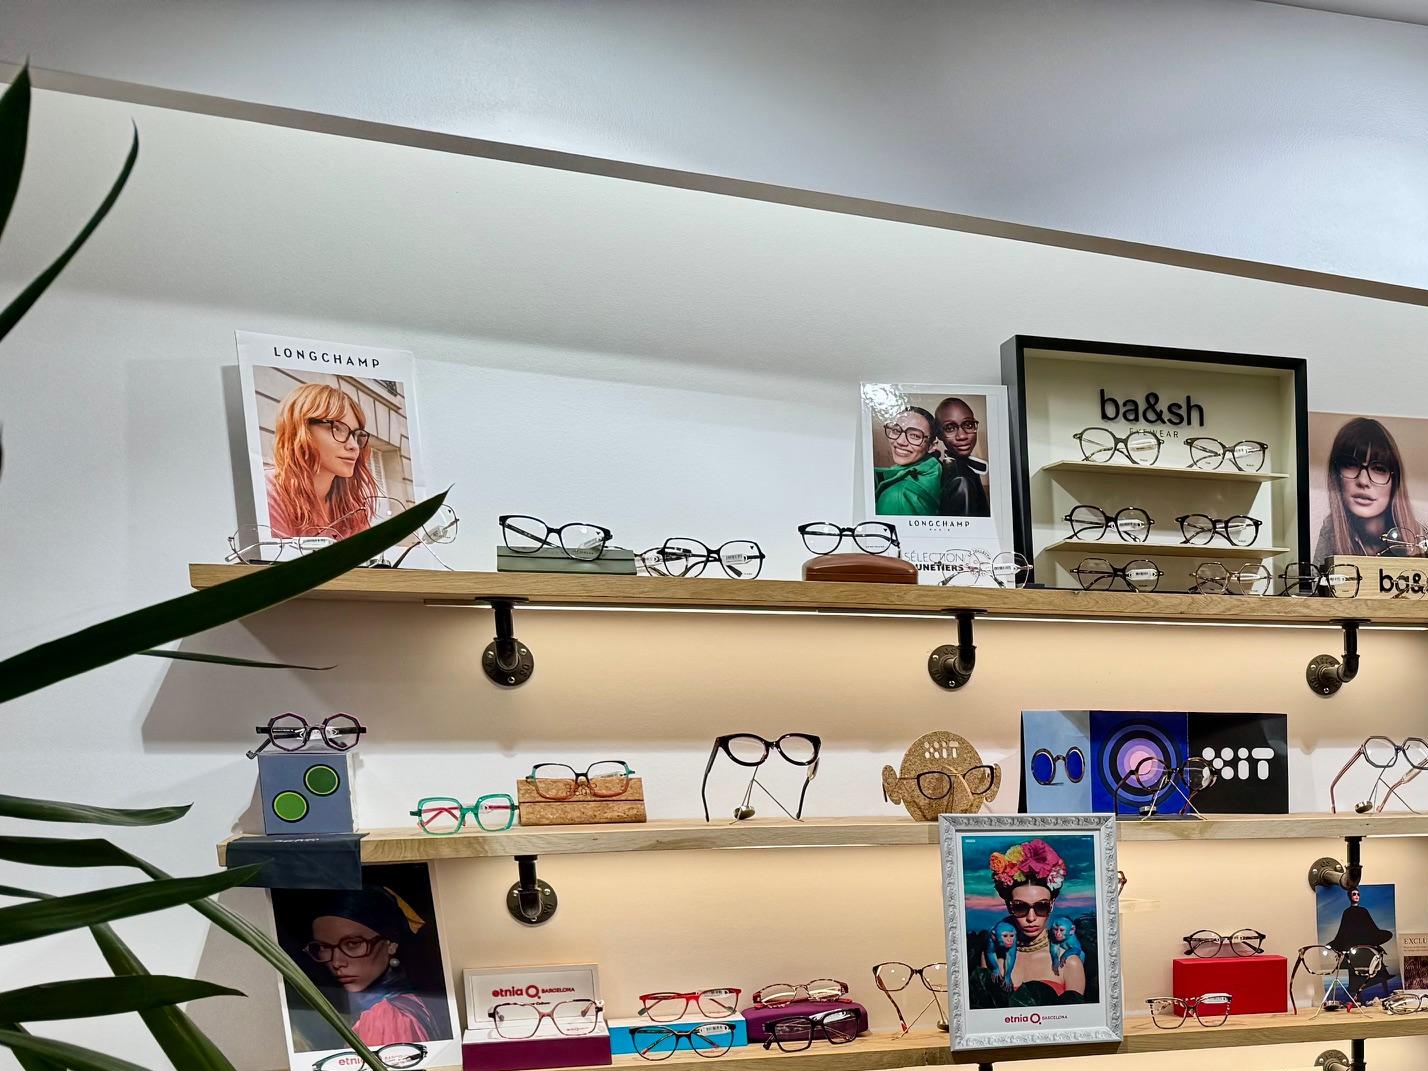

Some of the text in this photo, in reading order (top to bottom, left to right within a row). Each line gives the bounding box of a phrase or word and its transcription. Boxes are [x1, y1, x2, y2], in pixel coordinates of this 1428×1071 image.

[273, 346, 380, 368] LONGCHAMP
[1099, 388, 1205, 427] ba&sh
[491, 985, 576, 997] etnia BARCELONA
[1004, 1013, 1029, 1023] etnia
